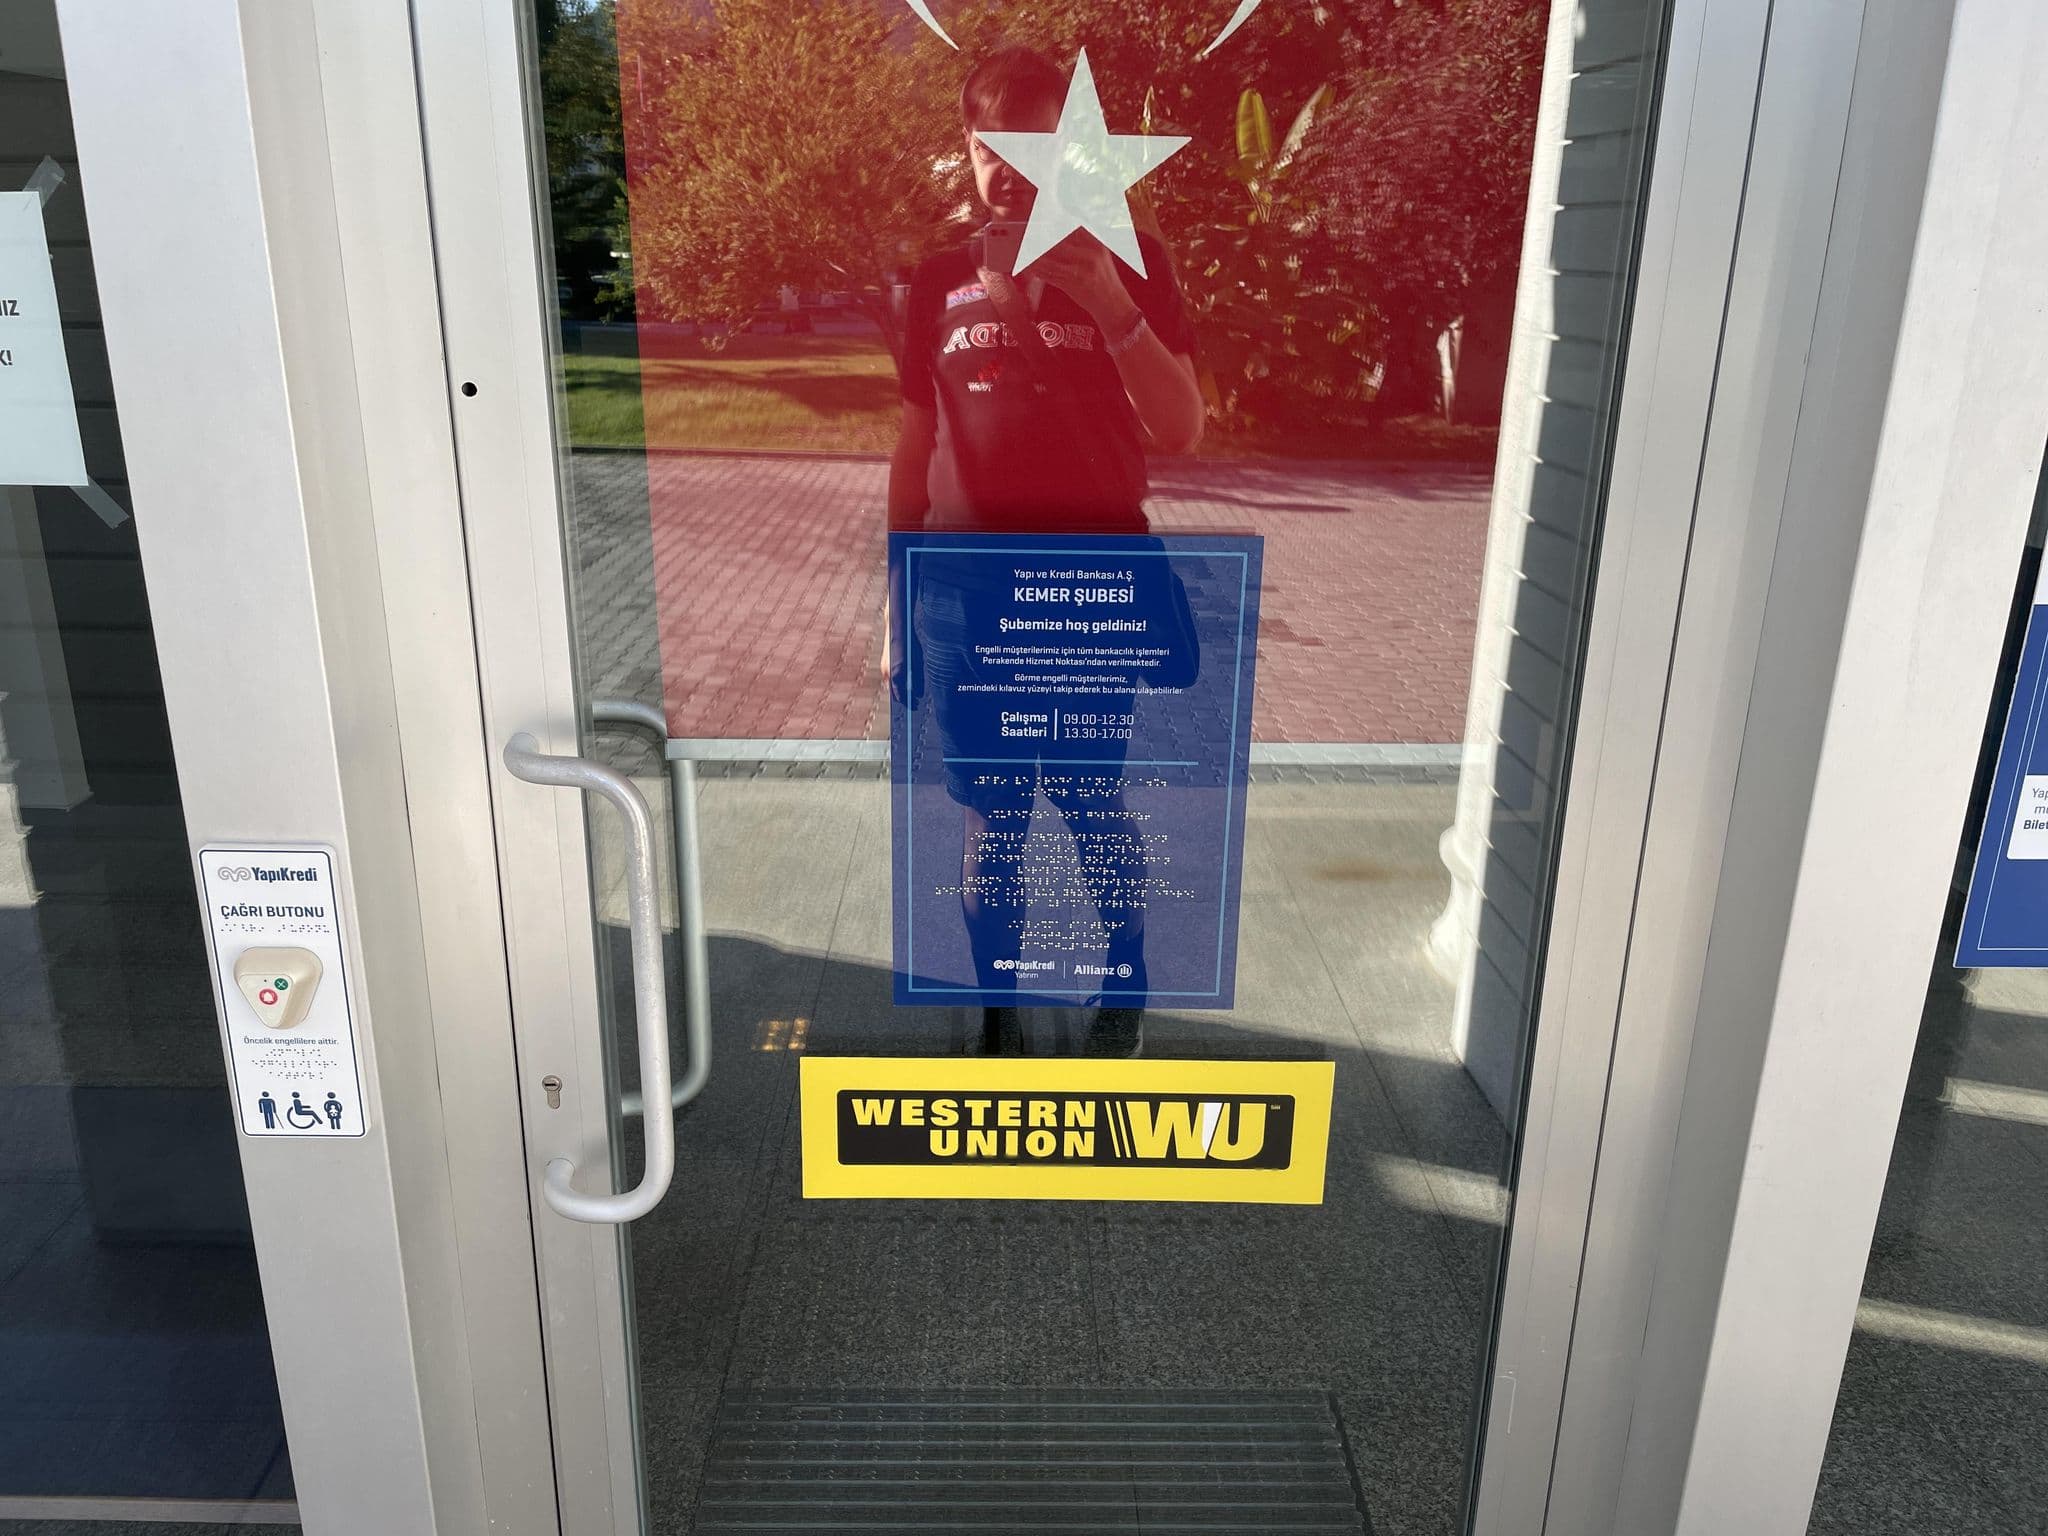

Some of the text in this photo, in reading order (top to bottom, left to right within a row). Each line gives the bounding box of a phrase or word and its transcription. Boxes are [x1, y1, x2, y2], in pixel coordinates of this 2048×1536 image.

[1014, 569, 1034, 580] Yapı
[1050, 570, 1074, 579] Kredi
[1077, 570, 1115, 580] Bankası
[1116, 571, 1134, 582] A.Ş.
[1014, 586, 1134, 606] KEMER ŞUBESİ
[1000, 618, 1146, 633] Şubemize hoş geldiniz!
[975, 645, 1170, 657] Engelli müşterilerimiz için tüm bankacılık işlemleri
[982, 657, 1024, 665] Perakende
[1026, 657, 1054, 665] Hizmet
[1108, 659, 1161, 667] verilmektedir.
[1015, 673, 1128, 684] Görme engelli müşterilerimiz,
[958, 684, 997, 692] zemindeki
[999, 684, 1025, 692] kılavuz
[1027, 685, 1052, 694] yüzeyi
[1053, 685, 1073, 694] takip
[1075, 685, 1100, 693] ederek
[1114, 686, 1136, 694] alana
[1137, 686, 1184, 695] ulaşabilirler.
[1001, 712, 1048, 725] Çalışma
[1063, 714, 1134, 725] 09.00-12.30
[1001, 727, 1047, 737] Saatleri
[1065, 728, 1132, 739] 13.30-17.00
[251, 867, 317, 883] YapıKredi
[221, 903, 324, 919] ÇAĞRI BUTONU
[1015, 960, 1055, 970] YapıKredi
[1074, 965, 1115, 975] Allianz
[243, 1035, 272, 1045] Öncelik
[275, 1037, 316, 1046] engellilere
[851, 1098, 1097, 1128] WESTERN
[1125, 1101, 1267, 1161] WU
[928, 1129, 1095, 1158] UNION
